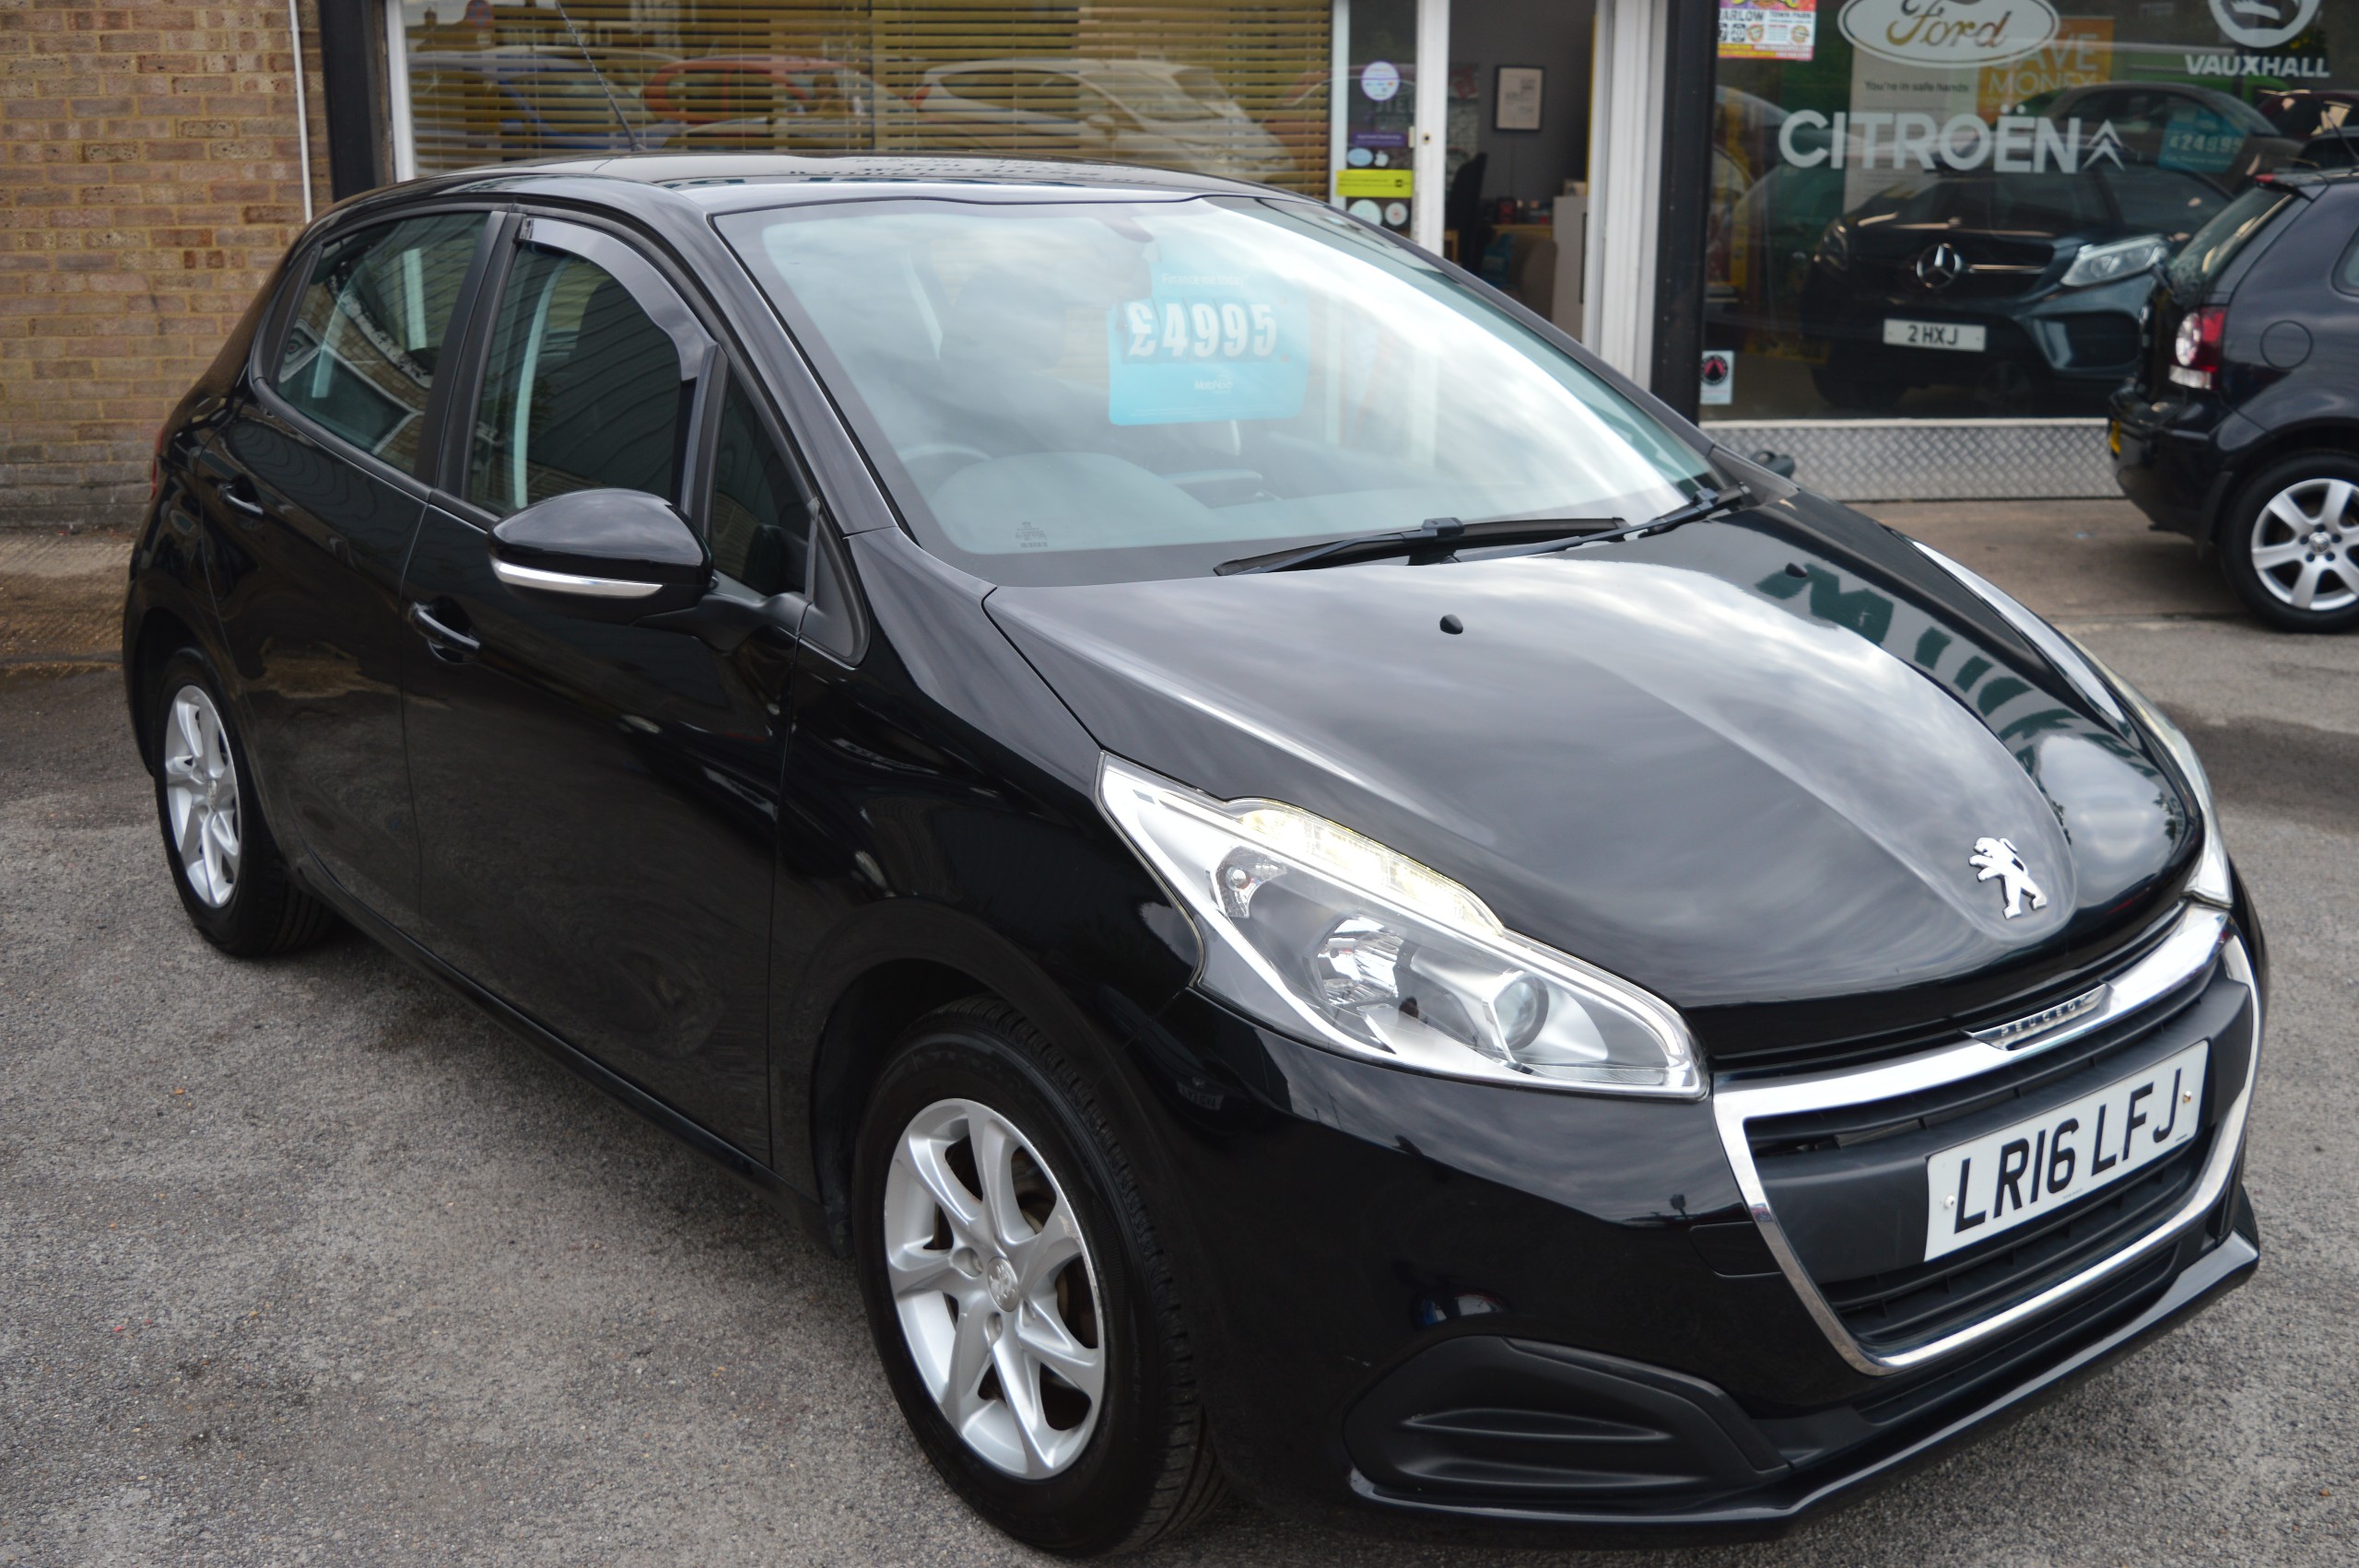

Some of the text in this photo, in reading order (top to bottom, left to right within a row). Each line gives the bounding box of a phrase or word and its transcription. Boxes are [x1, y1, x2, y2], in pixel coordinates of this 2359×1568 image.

[1719, 9, 1764, 21] ARLOW
[1885, 0, 2012, 47] Ford
[2185, 54, 2330, 77] VAUXHALL
[1864, 81, 1968, 93] You're in safe hands
[1778, 104, 2082, 174] CITROËN
[1127, 302, 1277, 357] £4995
[1907, 324, 1958, 345] 2 HXJ
[1954, 1067, 2182, 1235] LR16 LFJ
